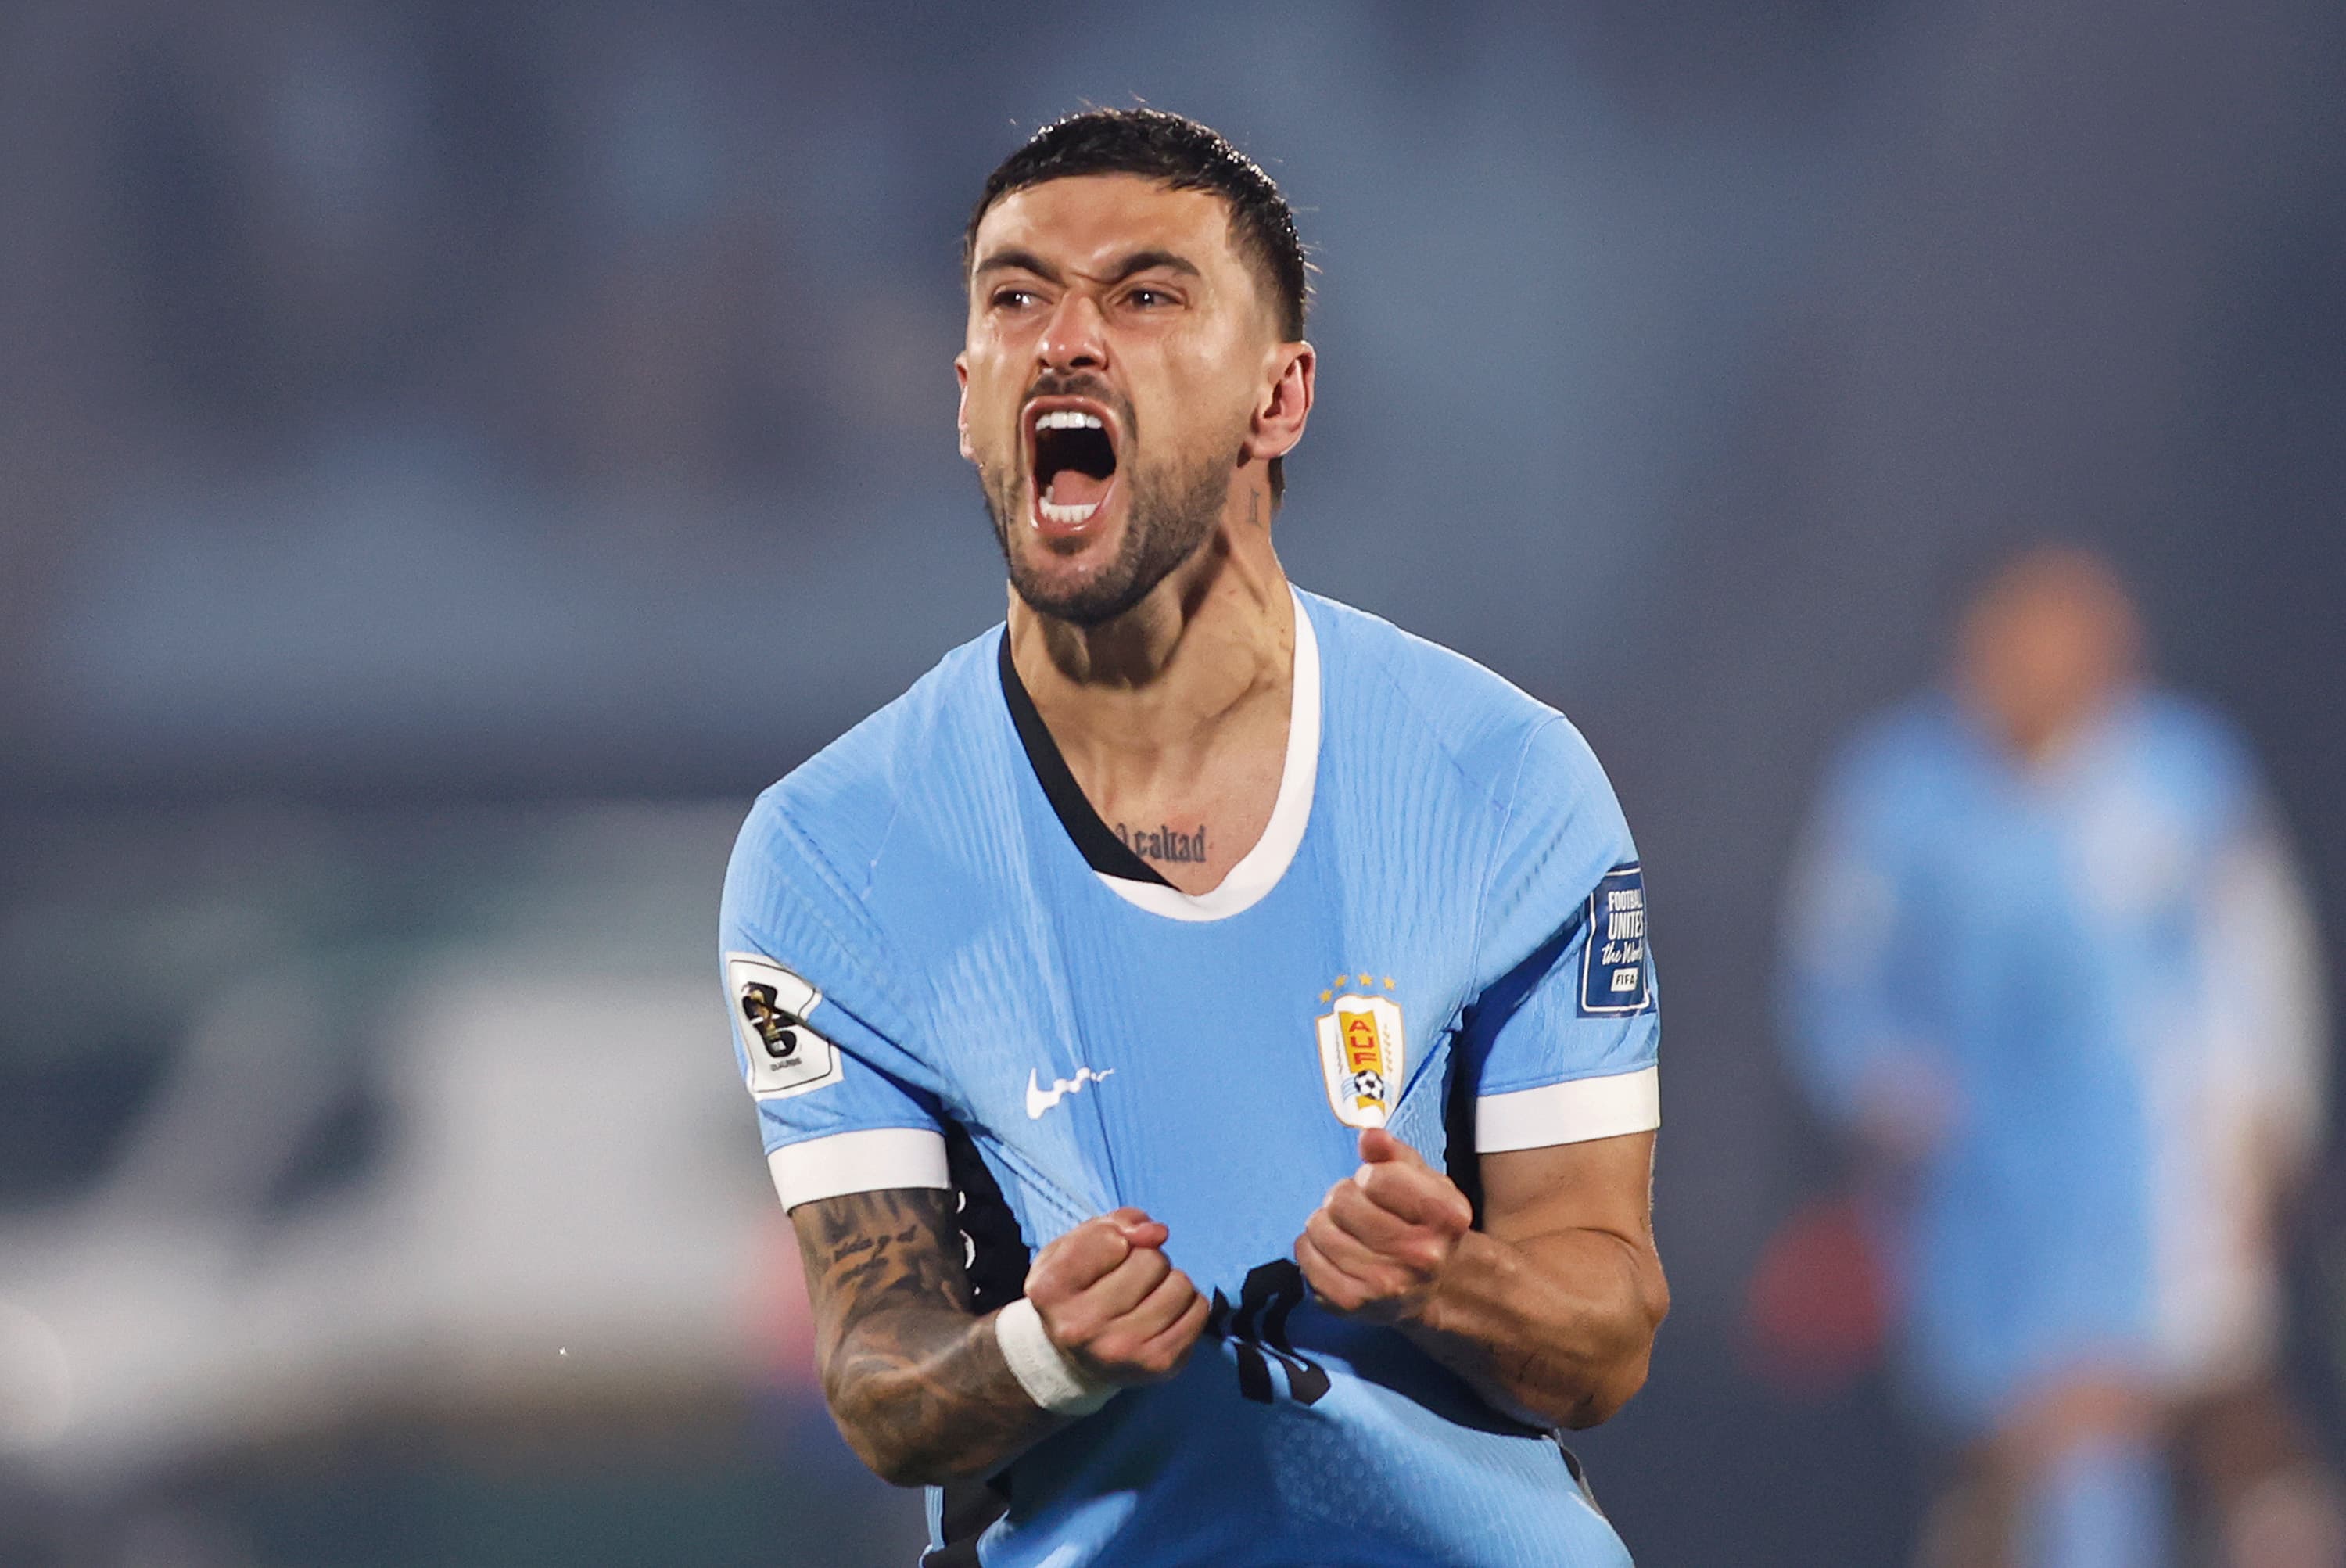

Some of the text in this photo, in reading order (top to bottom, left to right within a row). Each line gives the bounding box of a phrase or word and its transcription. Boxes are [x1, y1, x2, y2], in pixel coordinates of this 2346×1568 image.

[1602, 941, 1622, 966] the
[1615, 974, 1635, 985] FIFA
[1349, 1019, 1377, 1066] AUF
